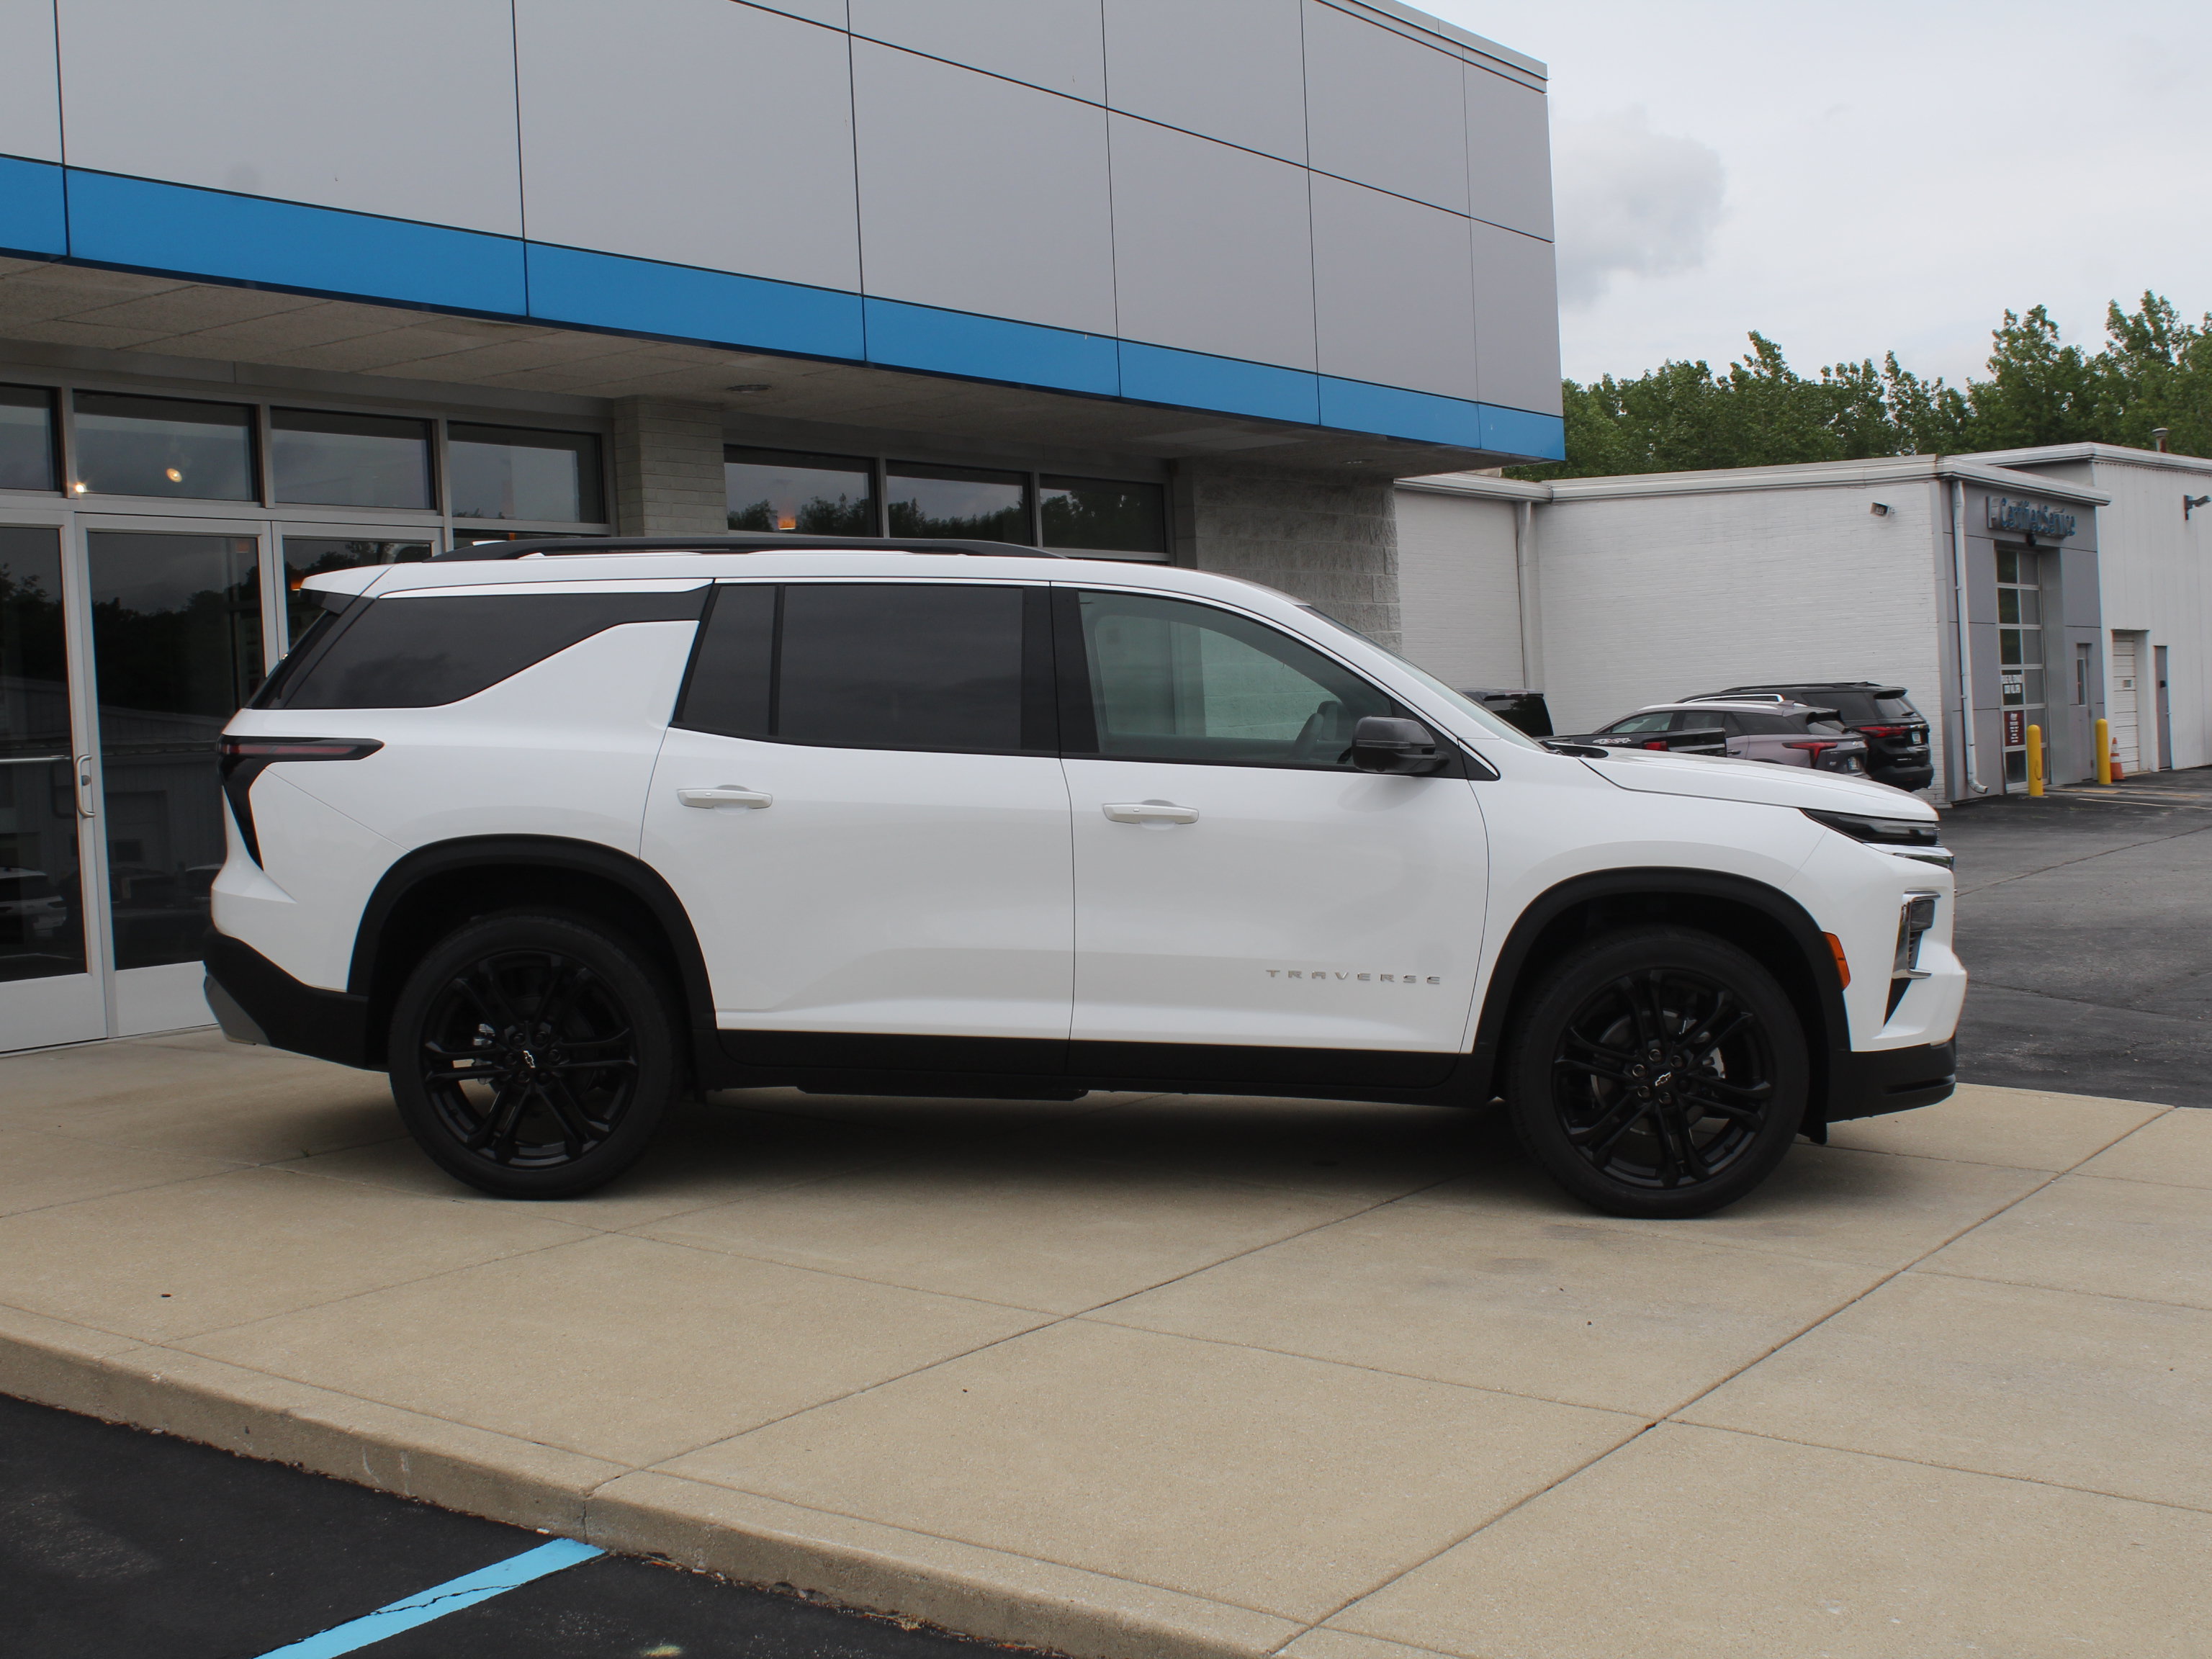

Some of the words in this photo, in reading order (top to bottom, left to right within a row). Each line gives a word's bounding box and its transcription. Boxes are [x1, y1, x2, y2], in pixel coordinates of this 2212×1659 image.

[2001, 498, 2042, 533] Certified
[2043, 505, 2075, 536] Service
[1265, 969, 1441, 985] TRAVERSE
